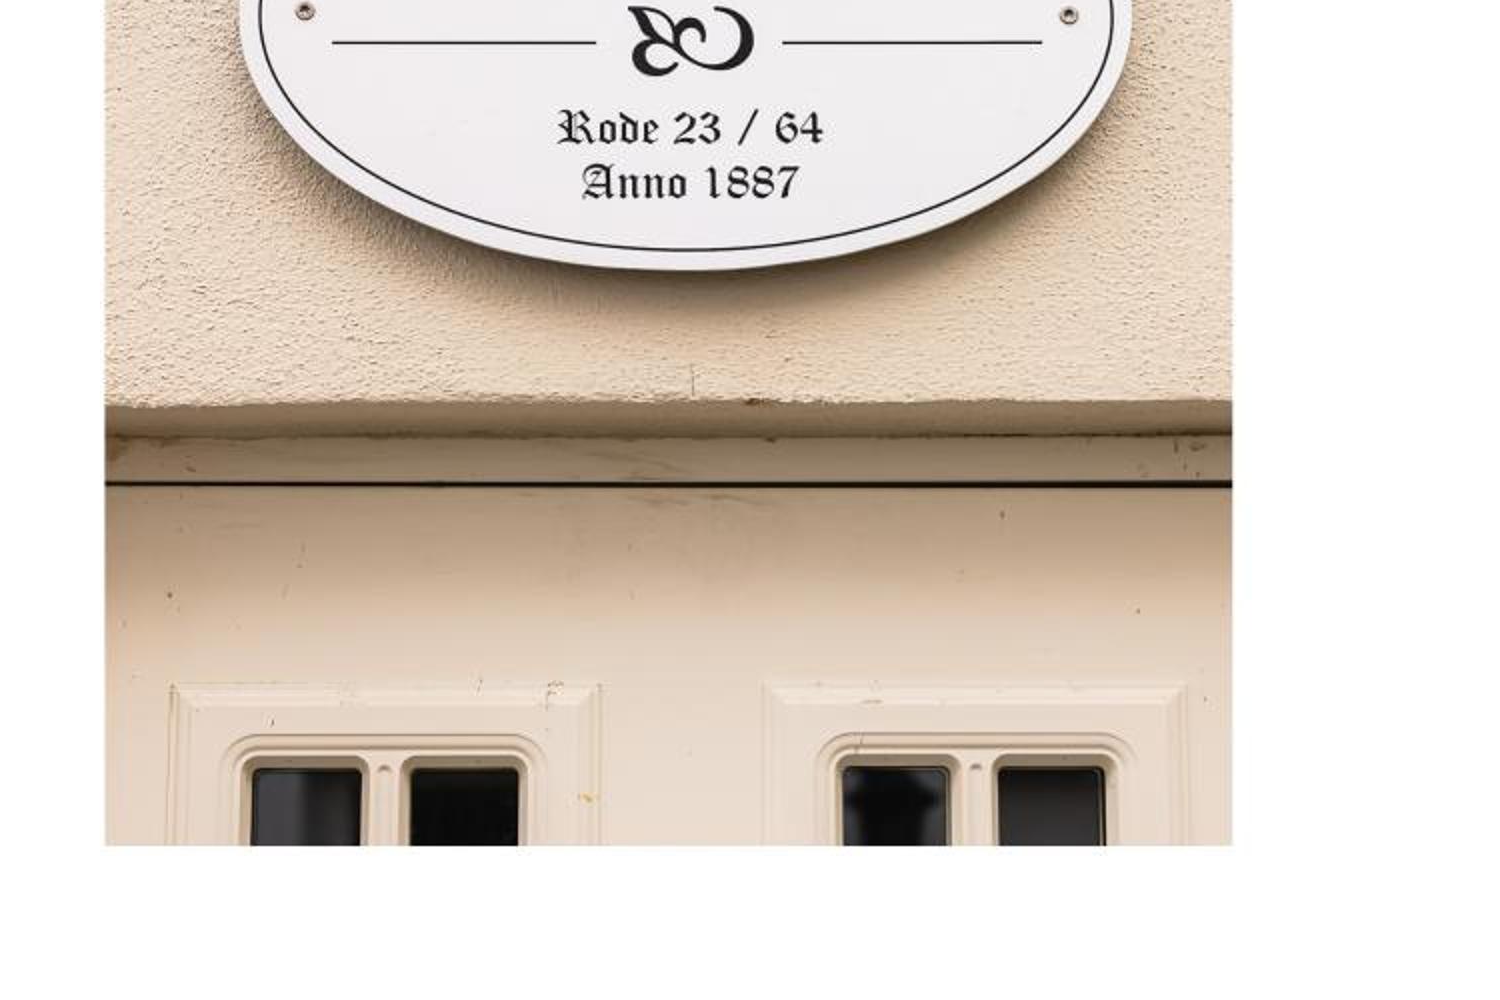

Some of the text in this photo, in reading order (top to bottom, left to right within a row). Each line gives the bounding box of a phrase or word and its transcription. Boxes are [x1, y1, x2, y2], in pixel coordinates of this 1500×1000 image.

[557, 108, 824, 146] Rode 23 / 64
[582, 163, 800, 199] Anno 1887
